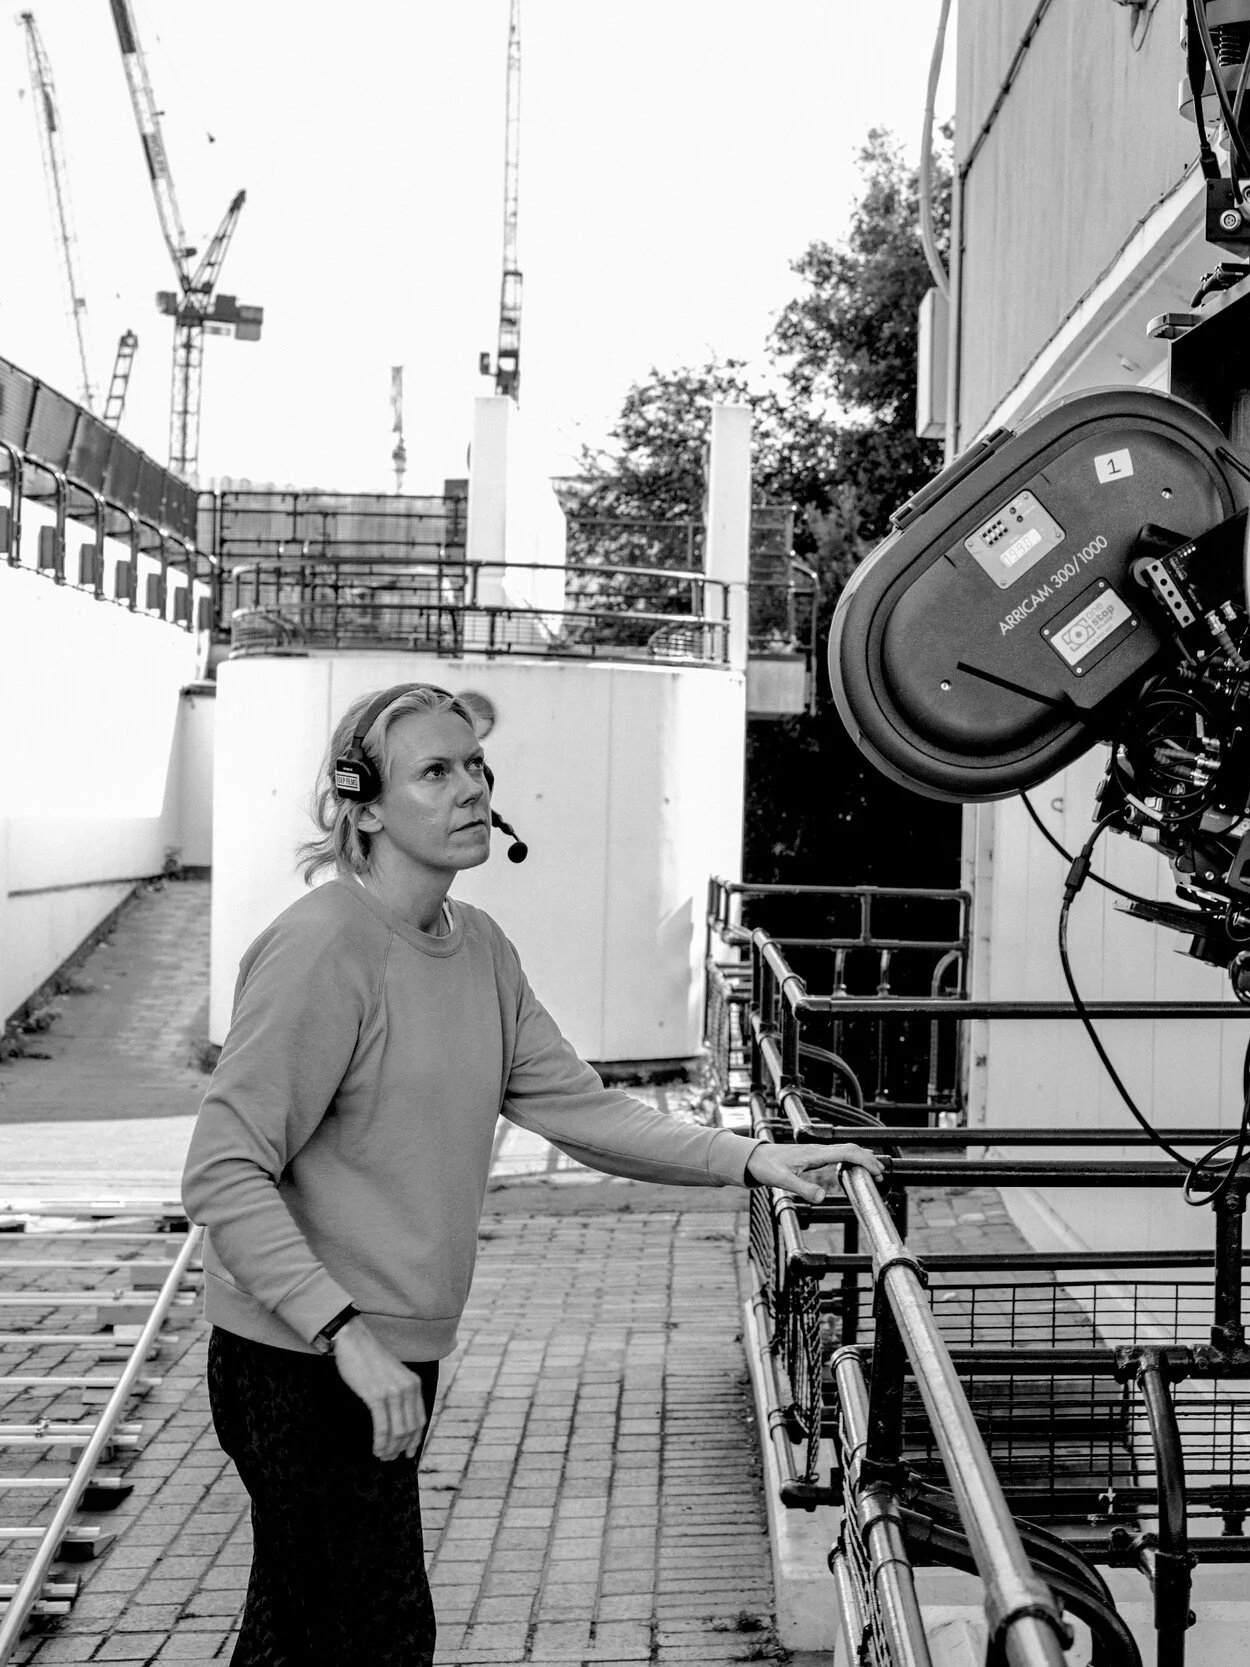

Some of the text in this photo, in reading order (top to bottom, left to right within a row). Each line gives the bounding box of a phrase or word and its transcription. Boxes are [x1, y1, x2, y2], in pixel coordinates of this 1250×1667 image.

[1107, 459, 1122, 475] 1
[999, 584, 1054, 636] ARRICAM
[1050, 535, 1108, 588] 300/1000
[1085, 602, 1104, 619] one
[1091, 604, 1115, 626] stop
